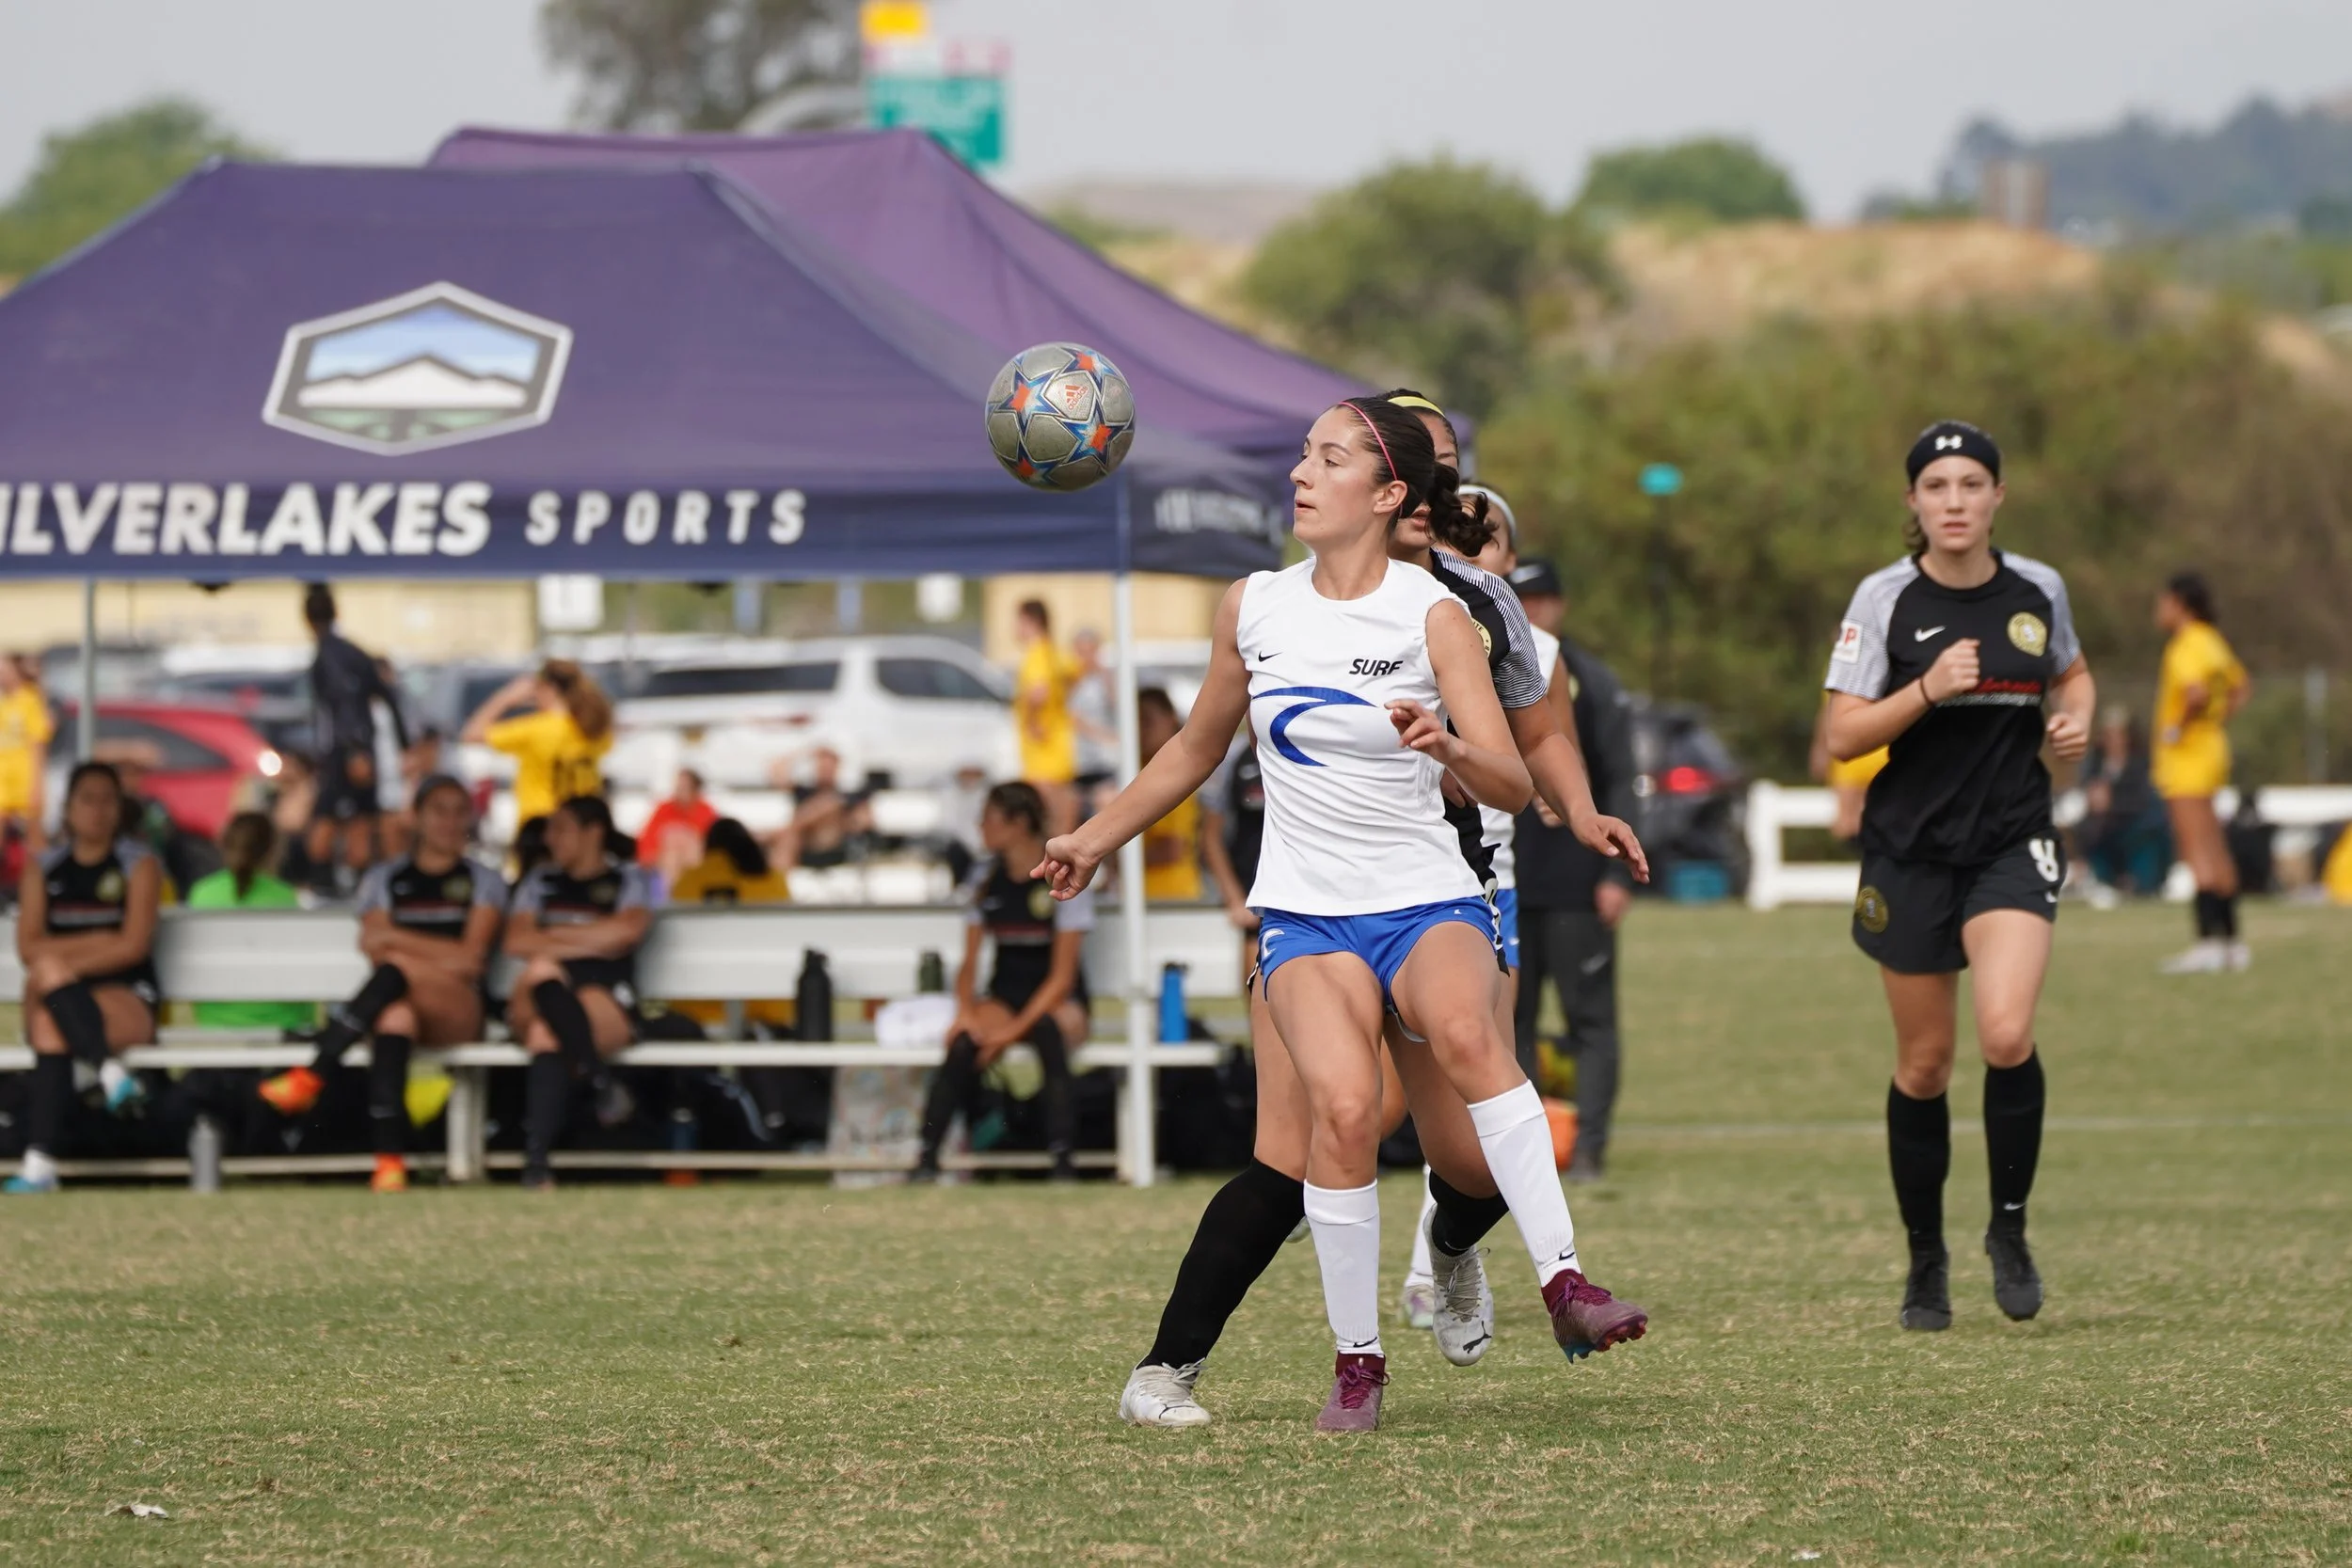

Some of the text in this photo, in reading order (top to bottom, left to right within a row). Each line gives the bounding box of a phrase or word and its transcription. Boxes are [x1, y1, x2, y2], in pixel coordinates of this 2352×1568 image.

[1068, 386, 1089, 410] adidas
[524, 489, 807, 546] SPORTS
[1349, 658, 1404, 676] SURF
